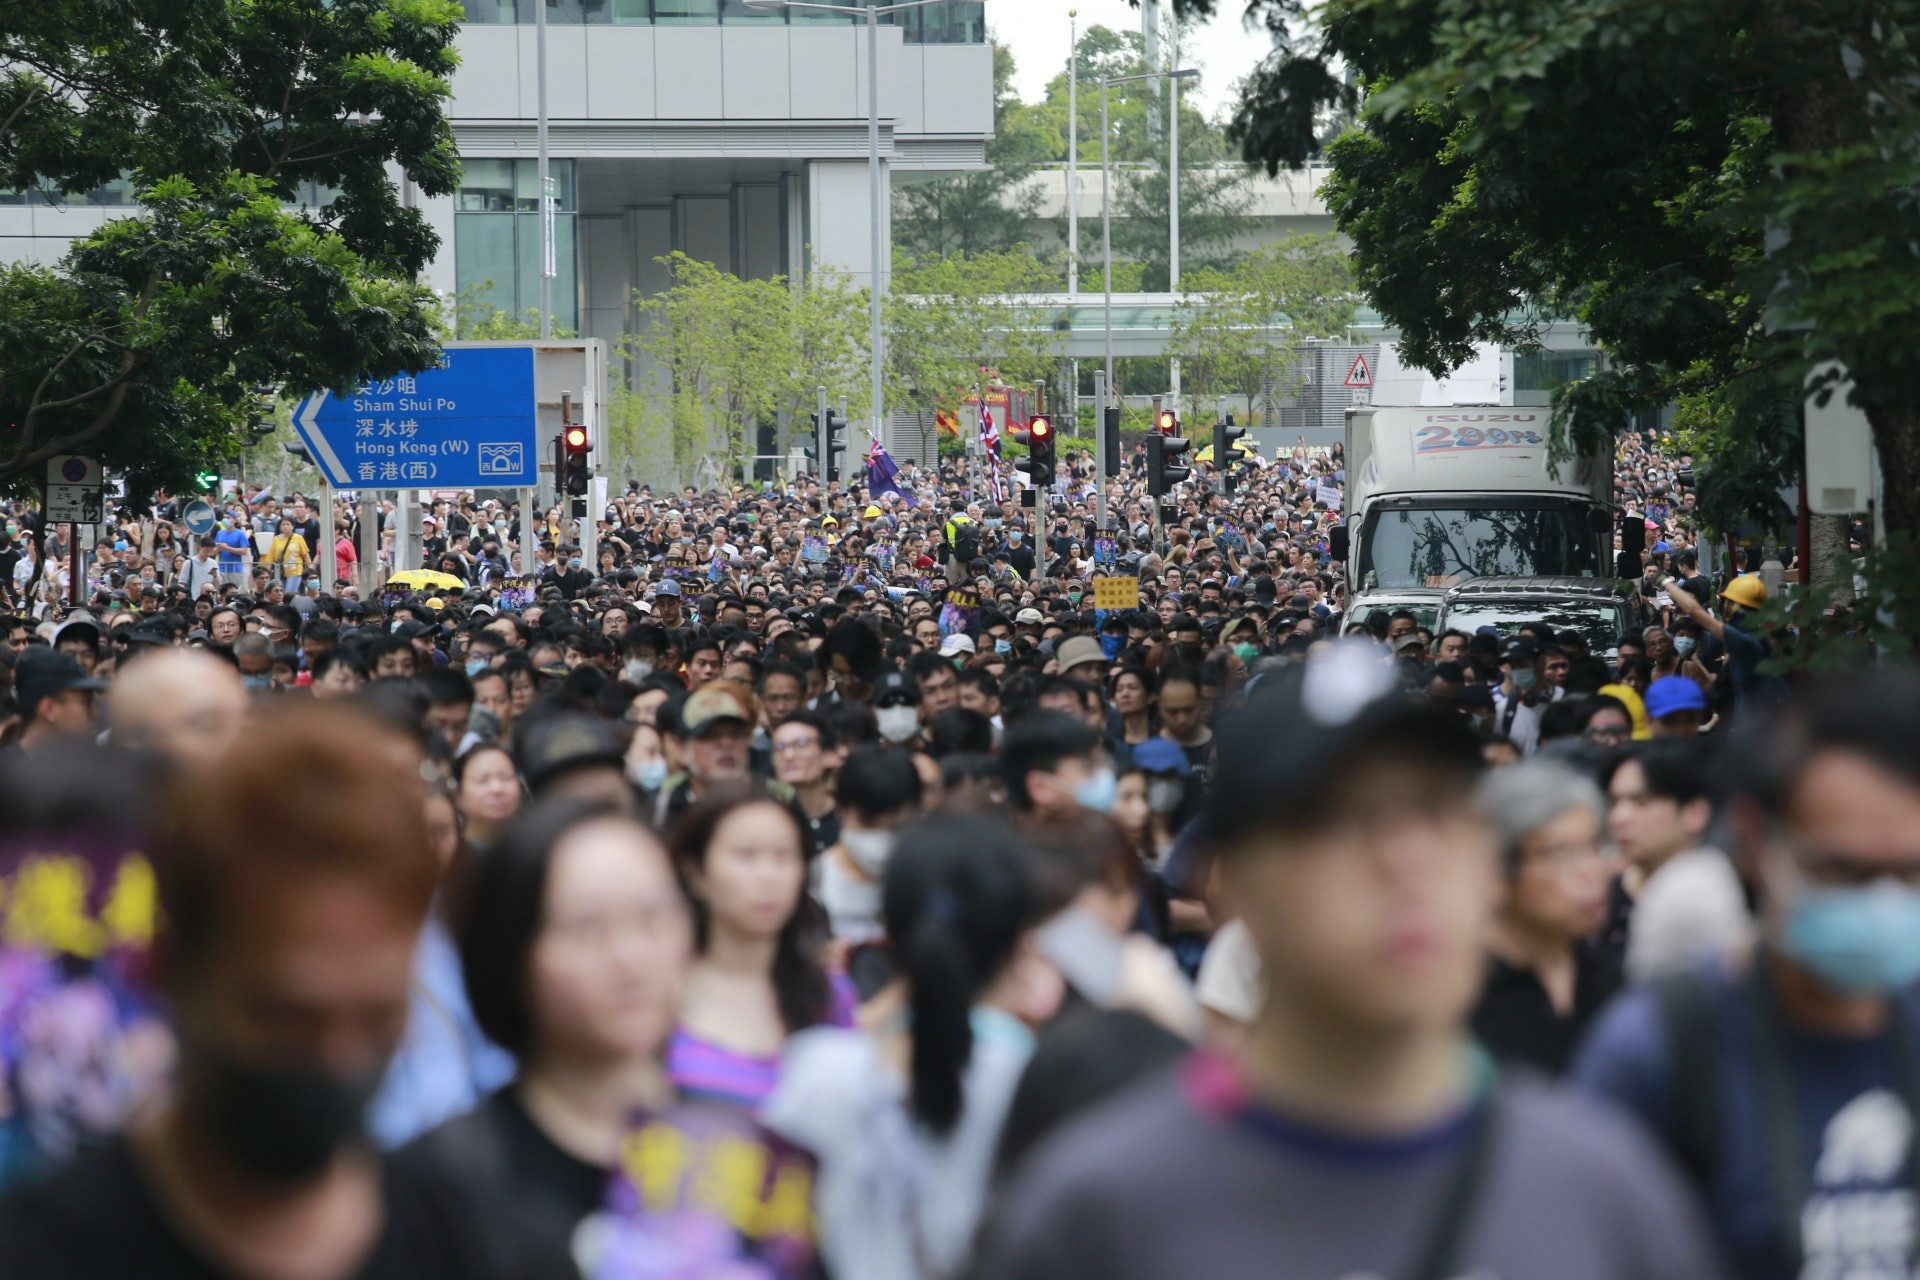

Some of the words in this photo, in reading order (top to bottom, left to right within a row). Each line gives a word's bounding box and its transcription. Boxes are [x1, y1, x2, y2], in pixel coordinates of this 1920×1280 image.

[353, 399, 394, 411] Sham
[399, 398, 432, 411] Shui
[437, 398, 456, 410] Po
[1426, 414, 1536, 422] ISUZU
[355, 418, 419, 438] 深水埗
[355, 441, 395, 457] Hong
[400, 440, 437, 455] Kong
[441, 440, 470, 456] (W)
[510, 462, 520, 471] W
[83, 509, 98, 522] 12
